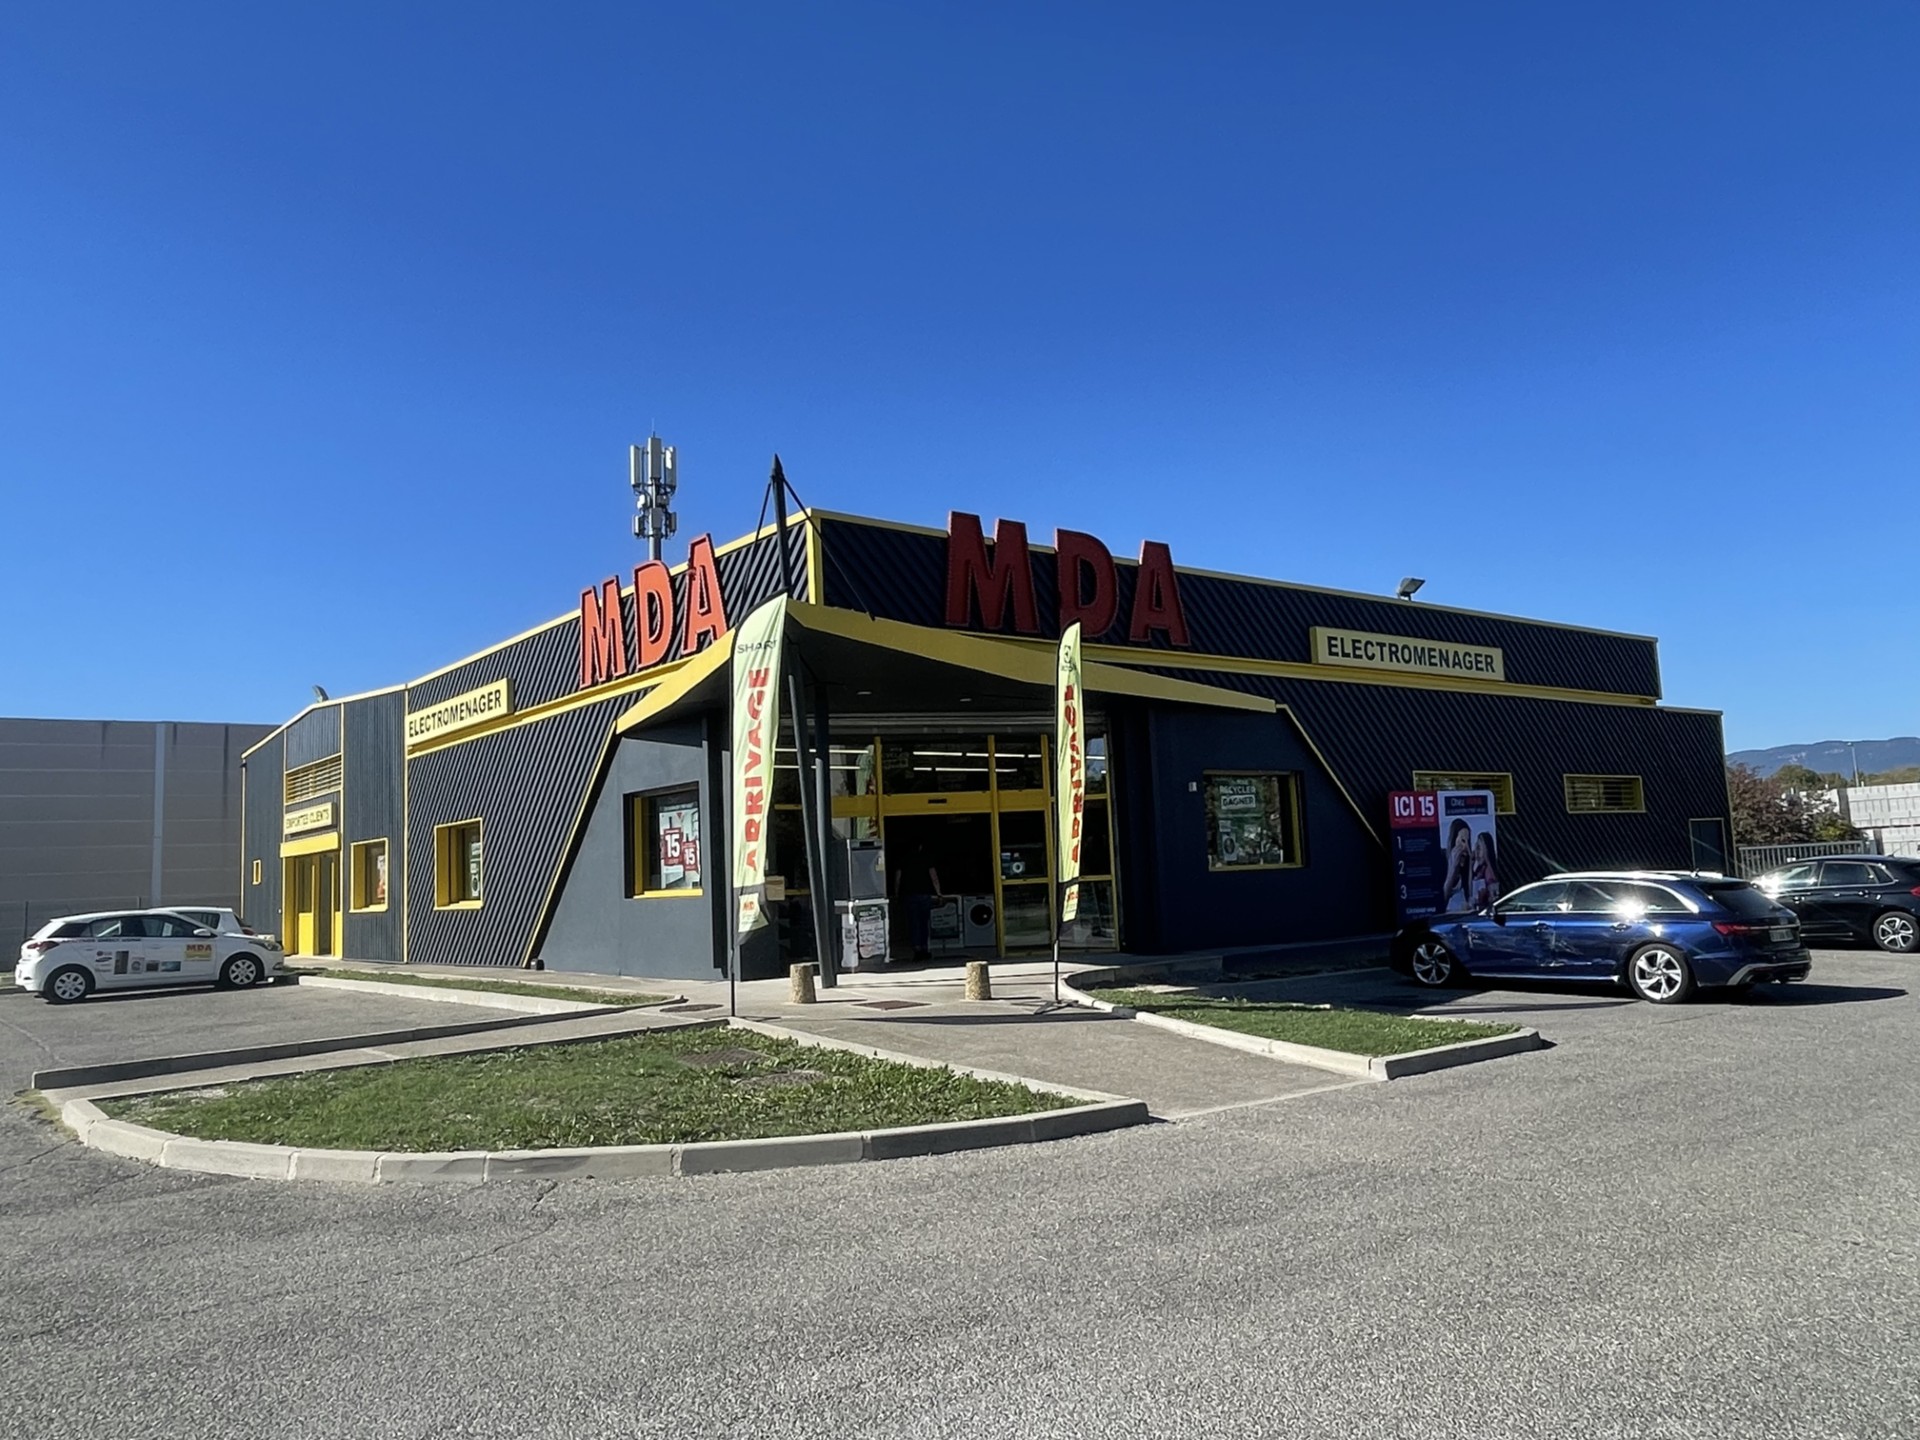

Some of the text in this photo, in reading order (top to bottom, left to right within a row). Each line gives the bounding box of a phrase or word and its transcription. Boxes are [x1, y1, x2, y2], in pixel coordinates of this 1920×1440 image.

[946, 511, 1190, 646] MDA
[579, 533, 728, 689] MDA
[1326, 635, 1496, 673] ELECTROMENAGER
[408, 689, 502, 738] ELECTROMENAGER
[1394, 796, 1435, 817] ICI 15
[665, 833, 680, 858] 15
[684, 847, 696, 866] 15
